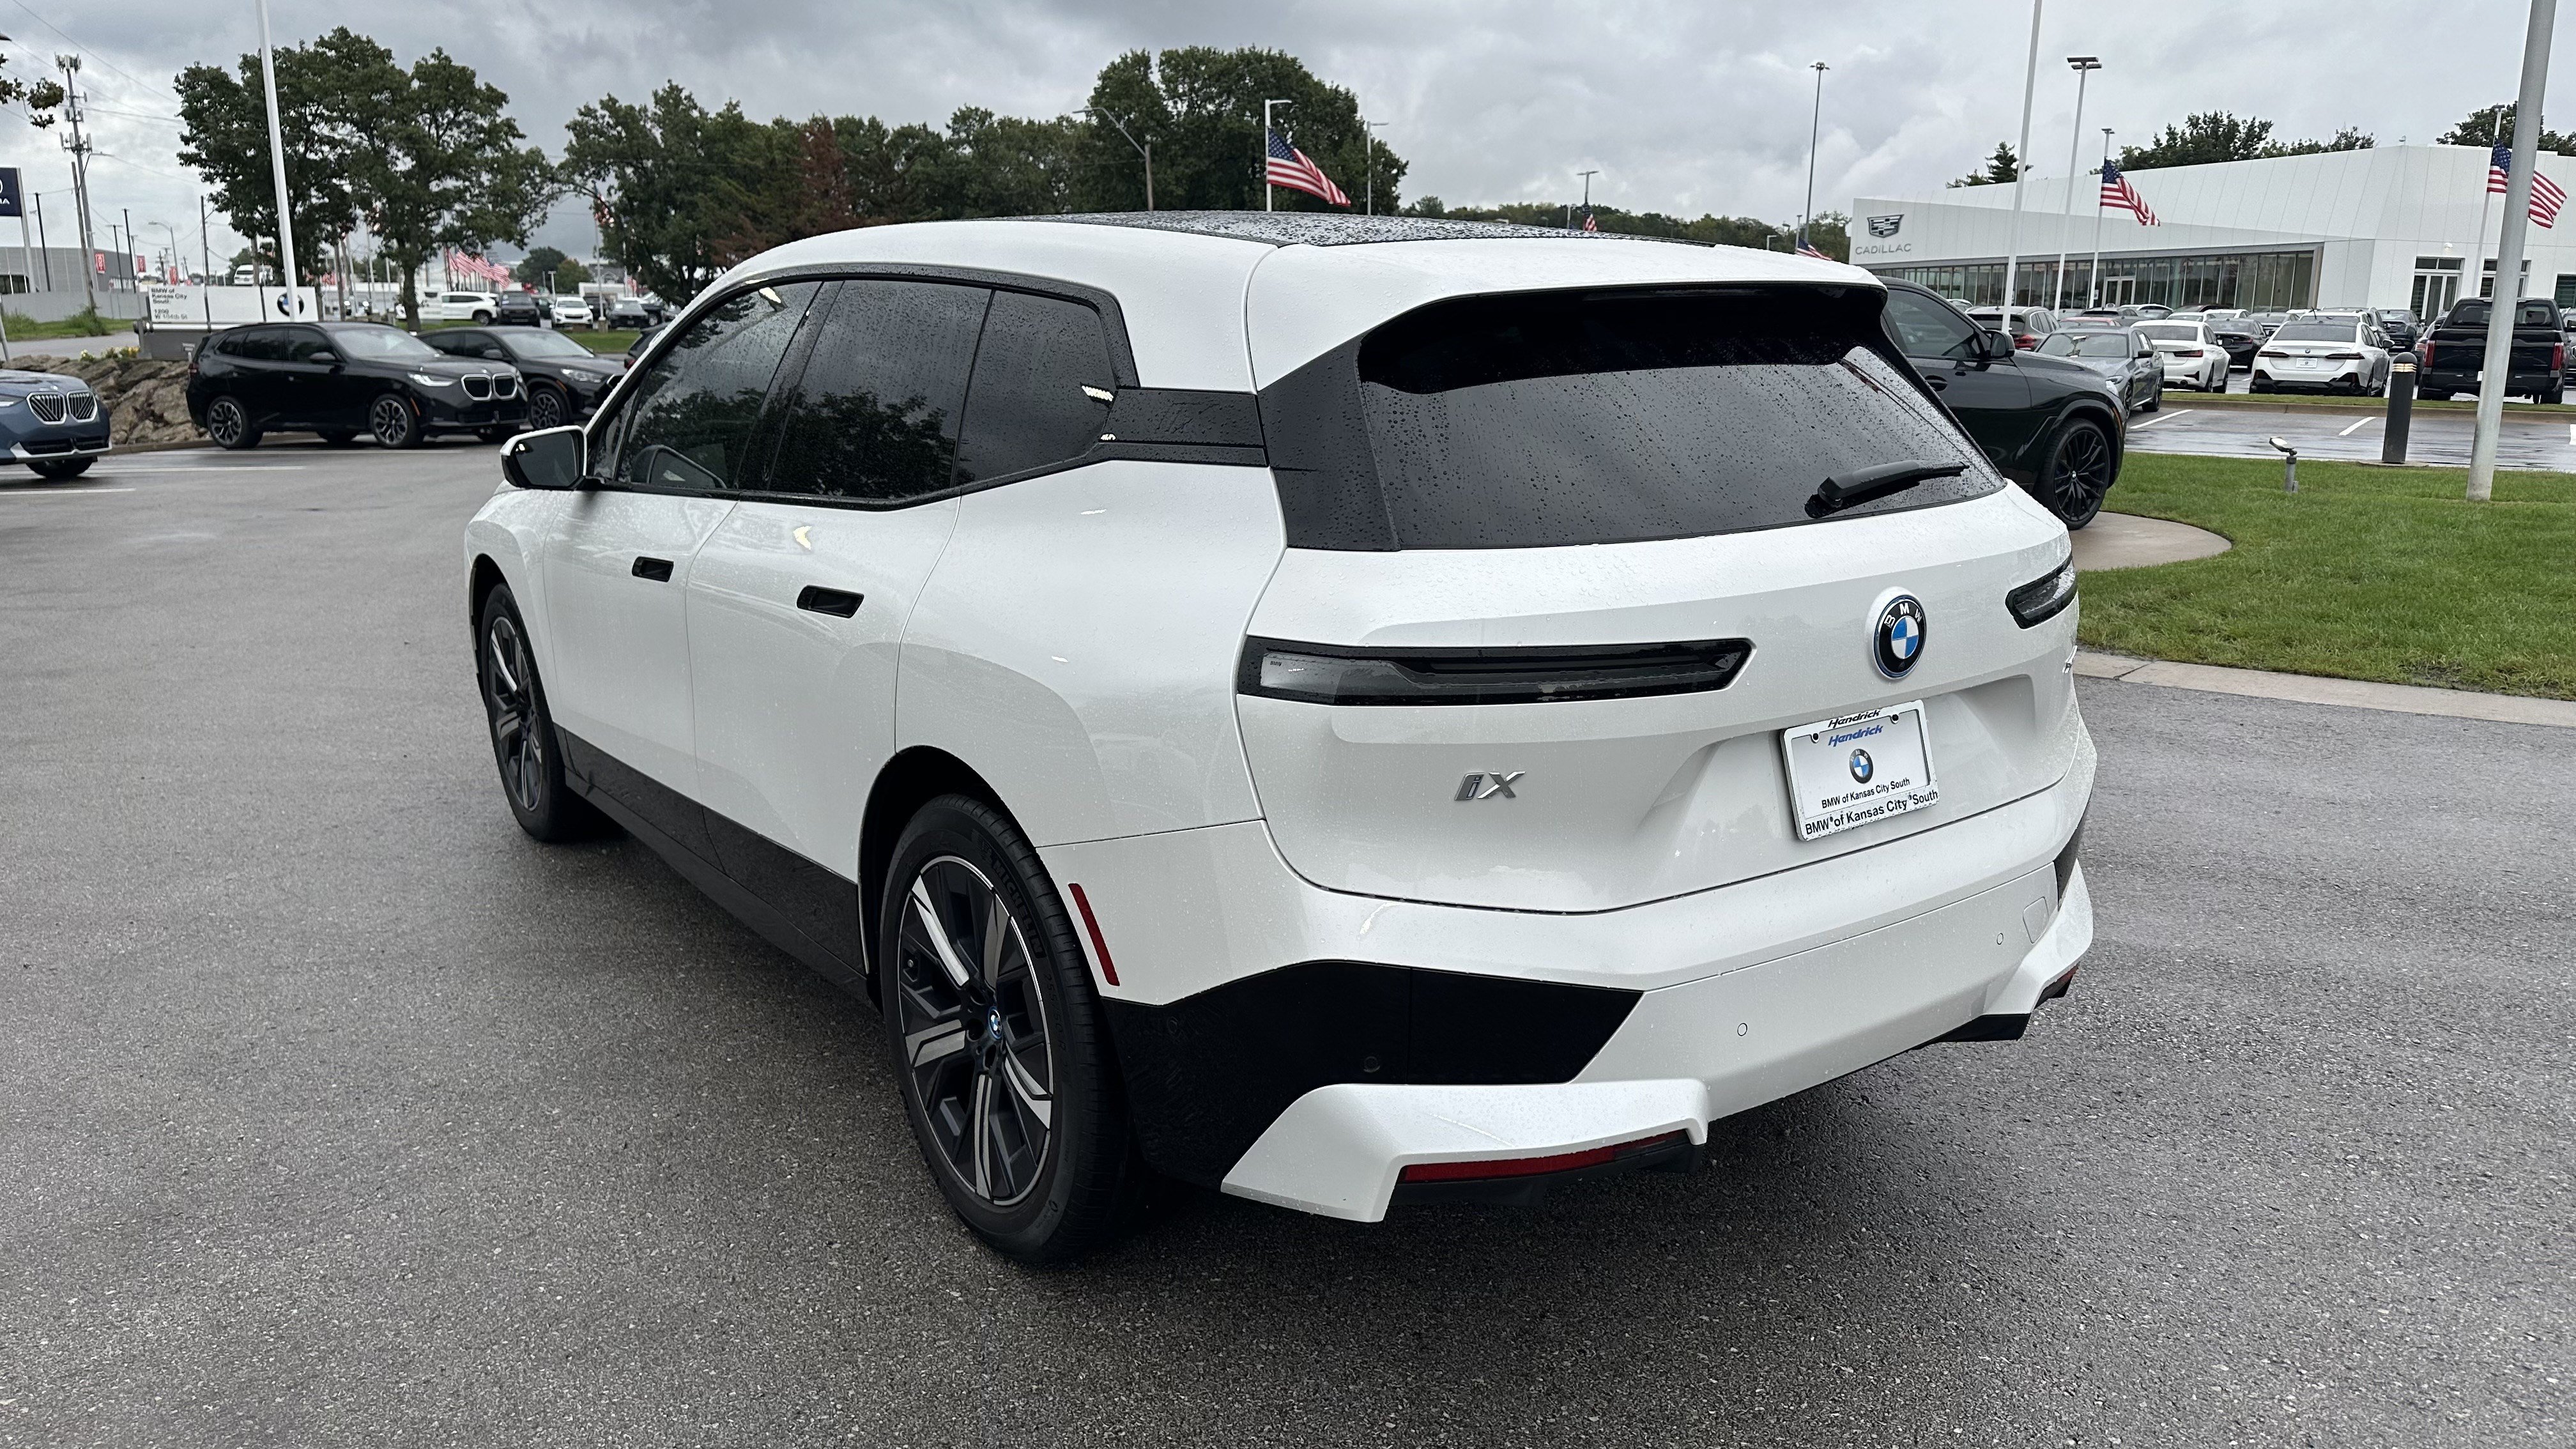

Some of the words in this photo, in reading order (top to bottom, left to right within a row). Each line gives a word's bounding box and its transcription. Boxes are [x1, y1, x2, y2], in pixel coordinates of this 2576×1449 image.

[1855, 243, 1912, 255] CADILLAC
[1884, 602, 1922, 628] BMW
[1828, 709, 1881, 728] Hendrick
[1828, 724, 1883, 747] Hendrick
[1821, 795, 1841, 809] BMW
[1842, 793, 1850, 803] of
[1850, 786, 1874, 801] Kansas
[1876, 784, 1889, 794] City
[1890, 778, 1910, 790] South
[1805, 817, 1830, 835] BMW
[1834, 814, 1845, 827] of
[1846, 804, 1885, 824] Kansas
[1887, 798, 1908, 813] City
[1912, 790, 1938, 805] South
[992, 861, 1046, 958] MICHELIN
